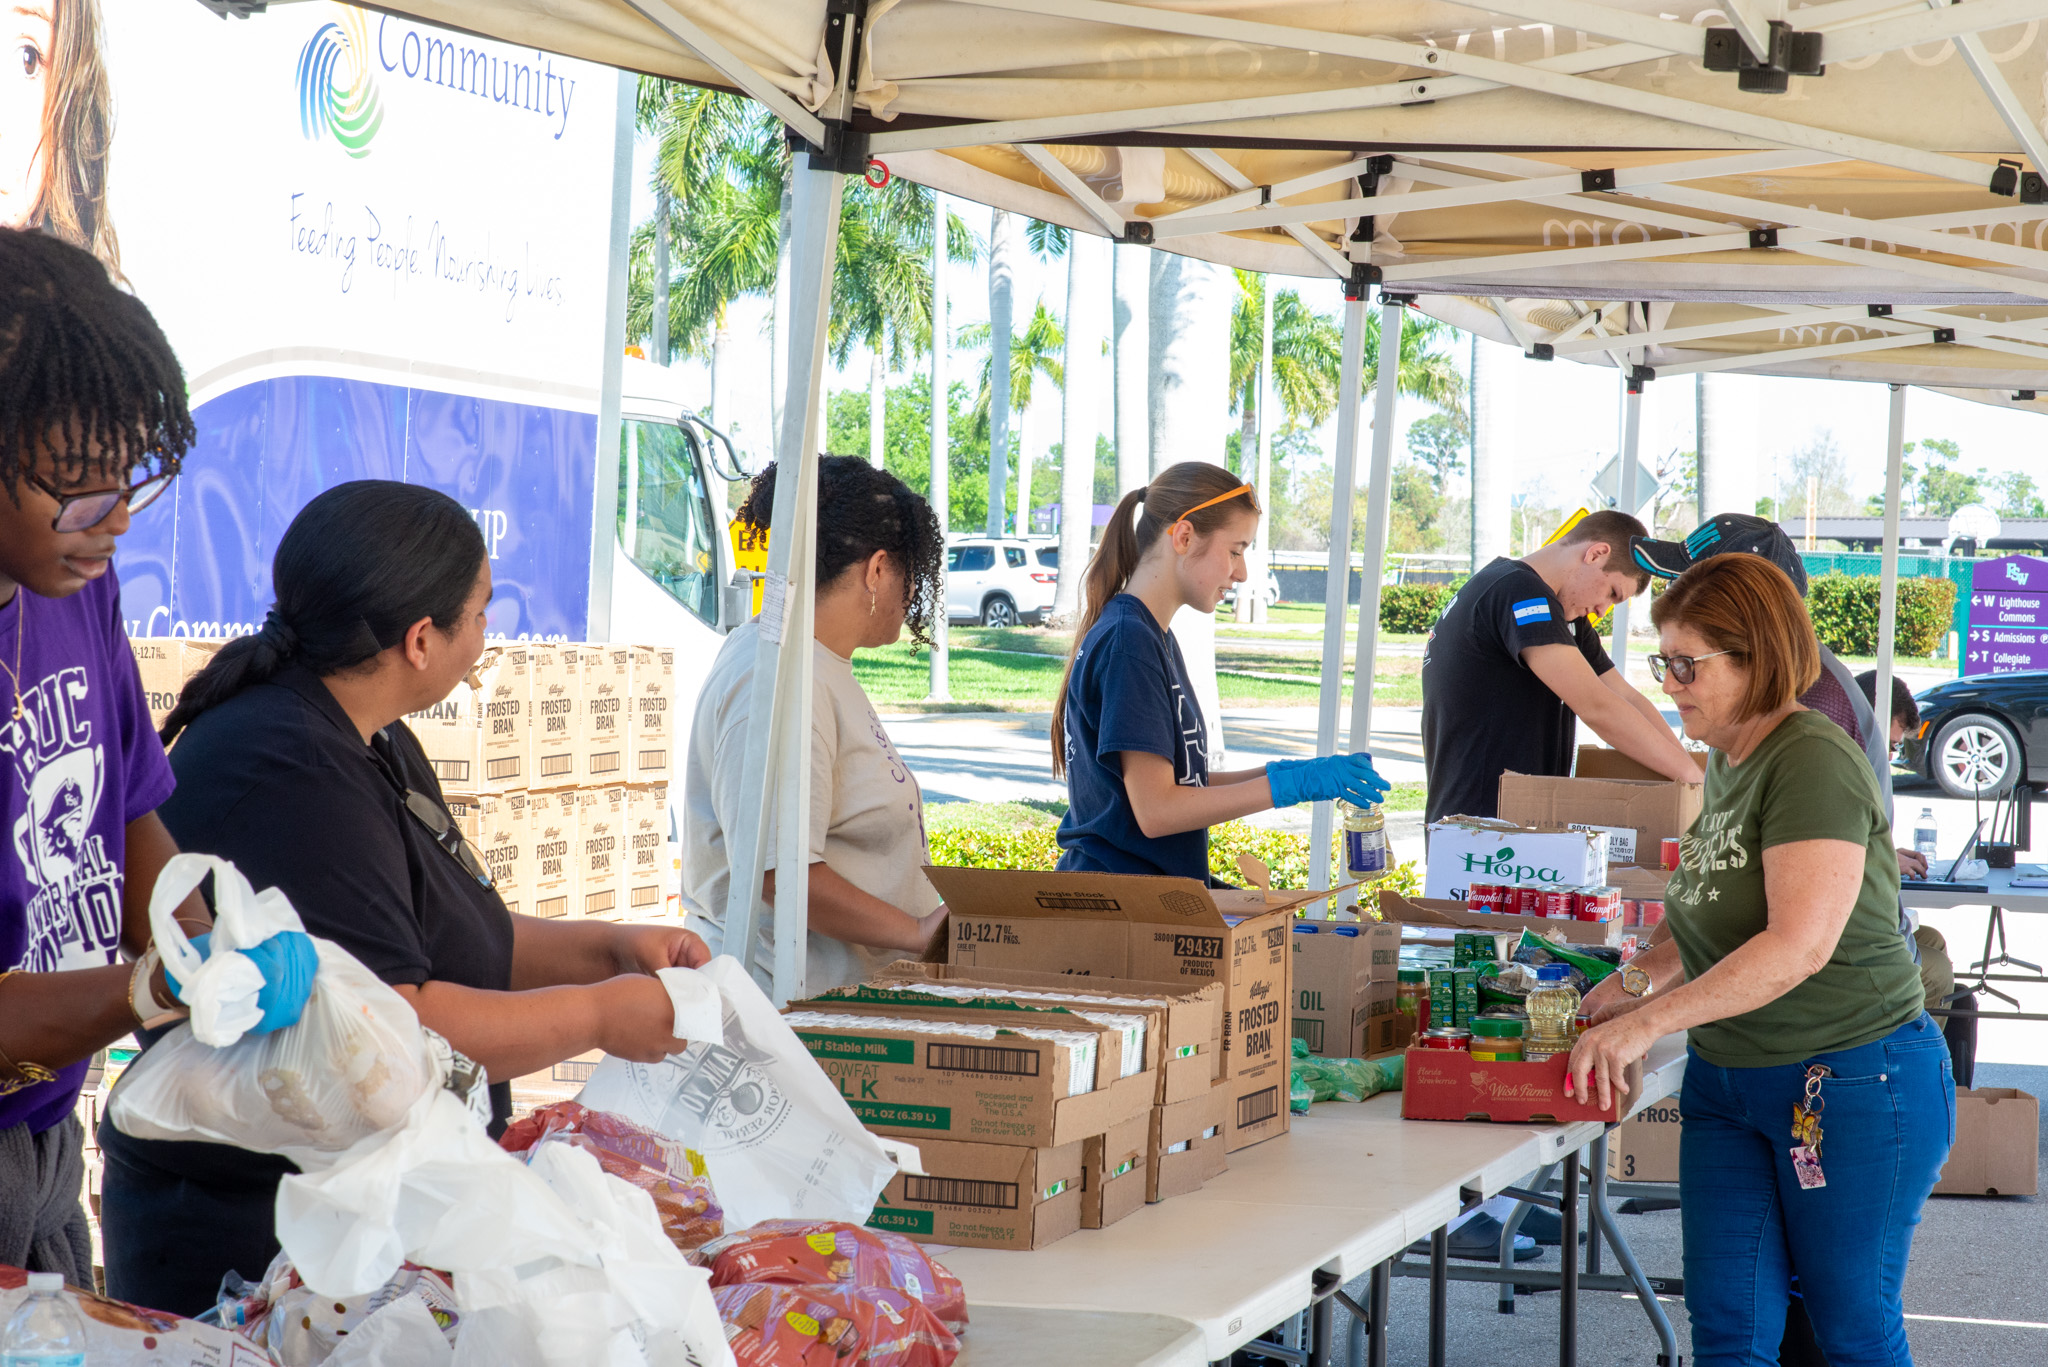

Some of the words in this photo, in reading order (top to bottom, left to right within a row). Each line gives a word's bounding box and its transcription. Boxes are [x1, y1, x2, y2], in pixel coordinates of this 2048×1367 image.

[379, 14, 576, 140] Community
[291, 192, 356, 293] Feeding
[365, 206, 422, 299] People.
[428, 220, 518, 322] Nourishing
[1983, 595, 1995, 607] W
[1999, 597, 2040, 610] Lighthouse
[1999, 611, 2036, 623] Commons
[1982, 630, 1990, 642] S
[1994, 632, 2036, 644] Admissions
[132, 646, 155, 659] 0-12.7
[1981, 651, 1989, 662] T
[1993, 652, 2031, 665] Collegiate
[486, 700, 520, 718] FROSTED
[541, 699, 572, 716] FROSTED
[590, 698, 620, 714] FROSTED
[639, 697, 667, 712] FROSTED
[493, 718, 514, 735] BRAN
[547, 716, 566, 732] BRAN
[596, 715, 615, 730] BRAN
[644, 713, 662, 728] BRAN
[586, 836, 615, 854] FROSTED
[632, 833, 660, 849] FROSTED
[1619, 837, 1629, 846] BAG
[536, 840, 568, 859] FROSTED
[637, 849, 655, 865] BRAN
[542, 858, 562, 876] BRAN
[591, 853, 610, 870] BRAN
[1456, 847, 1565, 883] Hopa
[1037, 890, 1072, 898] Single
[957, 922, 1003, 944] 10-12.7
[1003, 925, 1013, 935] OZ.
[1003, 934, 1021, 945] PKGS.
[1153, 932, 1174, 943] 38000
[1176, 938, 1222, 958] 29437
[1183, 959, 1213, 969] PRODUCT
[1180, 967, 1190, 976] OF
[1190, 967, 1215, 977] MEXICO
[861, 989, 876, 998] FL
[878, 991, 895, 999] OZ
[1300, 990, 1325, 1011] OIL
[1224, 1011, 1232, 1036] BRAN
[1239, 1001, 1279, 1033] FROSTED
[802, 1039, 822, 1051] helf
[825, 1041, 862, 1053] Stable
[865, 1043, 888, 1056] Milk
[1224, 1037, 1231, 1051] FR
[1246, 1028, 1271, 1057] BRAN
[1417, 1067, 1441, 1076] Florida
[1417, 1076, 1456, 1085] Strawberries
[840, 1078, 879, 1099] LK
[1489, 1083, 1518, 1097] Wish
[1519, 1083, 1553, 1098] Farms
[975, 1091, 1016, 1101] Processed
[1018, 1094, 1033, 1102] and
[978, 1099, 1018, 1110] Packaged
[984, 1107, 999, 1116] The
[853, 1108, 863, 1117] 16
[865, 1108, 877, 1118] FL
[879, 1110, 895, 1119] OZ
[897, 1111, 923, 1121] (6.39
[925, 1113, 937, 1123] L)
[970, 1126, 991, 1134] store
[984, 1119, 998, 1127] not
[1000, 1120, 1025, 1130] freeze
[1624, 1154, 1635, 1176] 3
[878, 1215, 905, 1225] (6.39
[907, 1217, 918, 1227] L)
[949, 1222, 961, 1230] Do
[963, 1223, 977, 1231] not
[979, 1224, 1004, 1233] freeze
[1006, 1228, 1015, 1236] or
[949, 1230, 968, 1238] store
[971, 1231, 989, 1239] over
